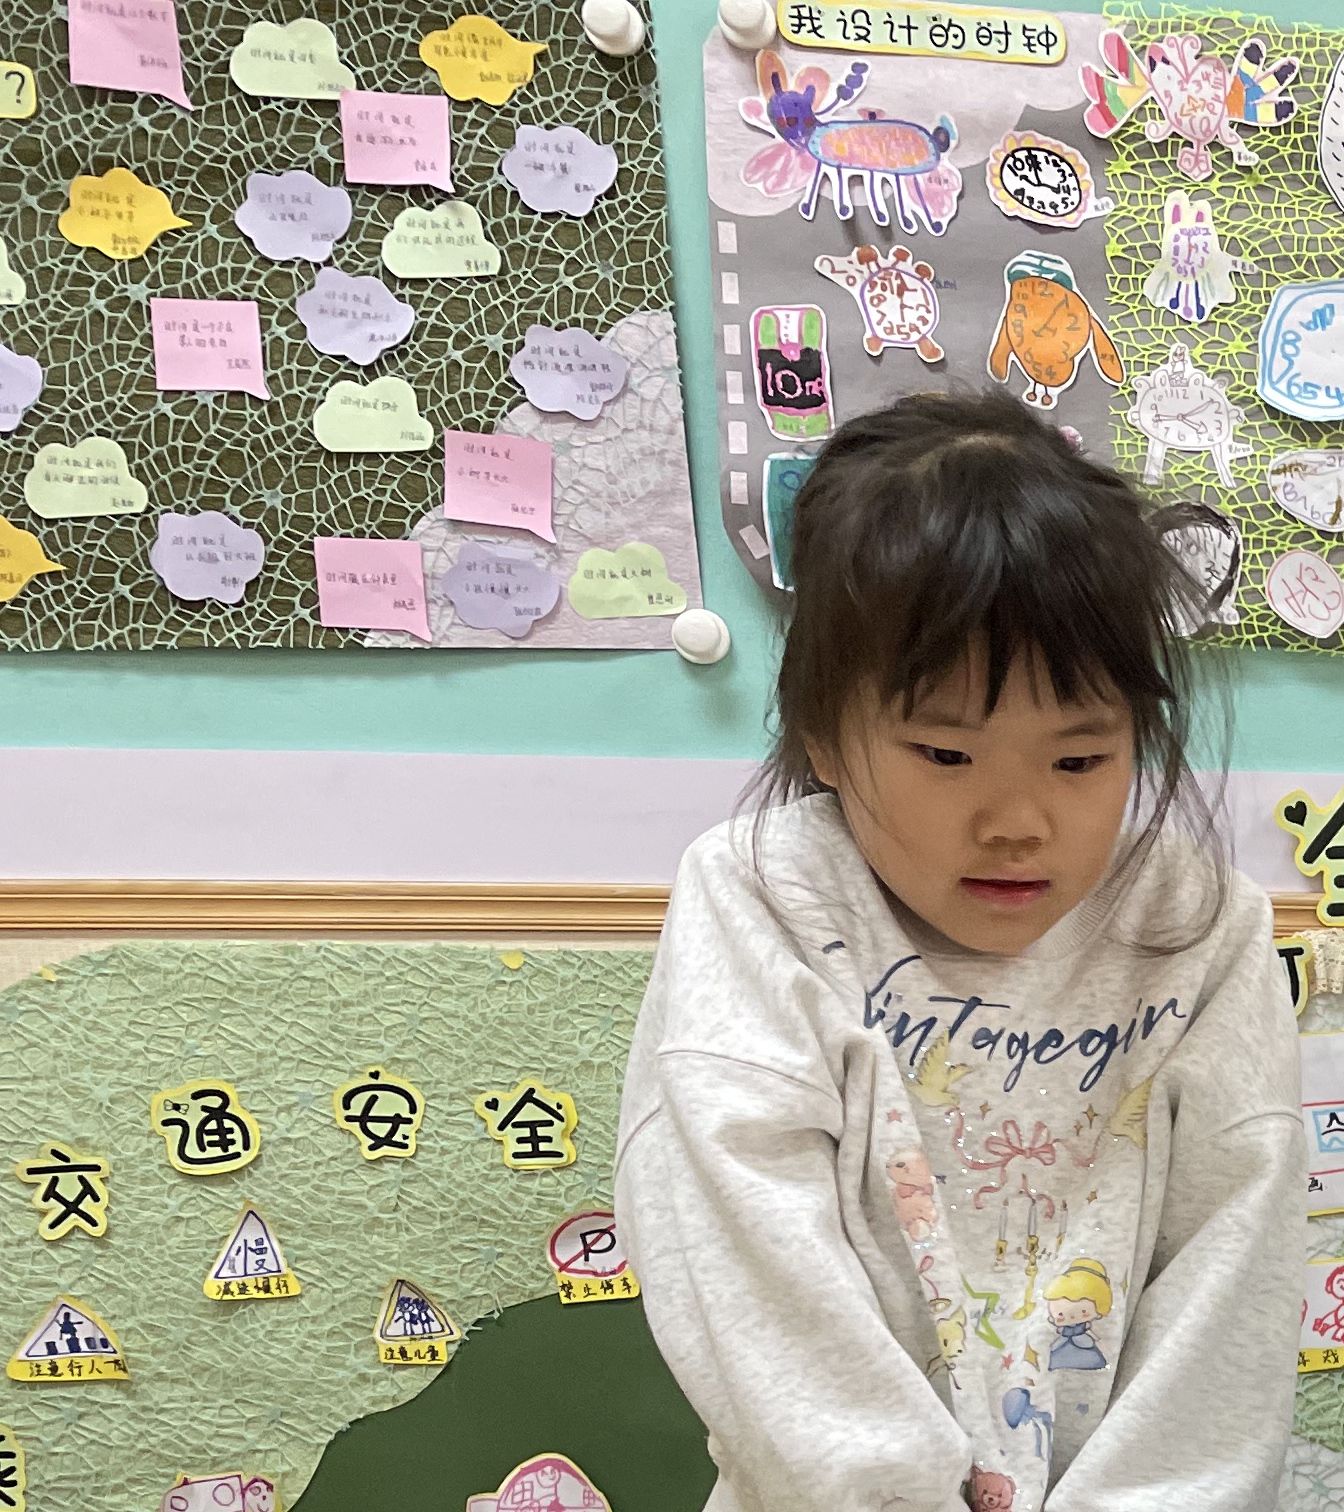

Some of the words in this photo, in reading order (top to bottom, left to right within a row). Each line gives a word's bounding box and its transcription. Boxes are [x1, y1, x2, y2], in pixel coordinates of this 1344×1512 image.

[788, 4, 1058, 55] 我设计的时钟
[27, 1084, 567, 1229] 交通安全
[236, 1238, 270, 1276] 慢
[580, 1228, 617, 1263] P
